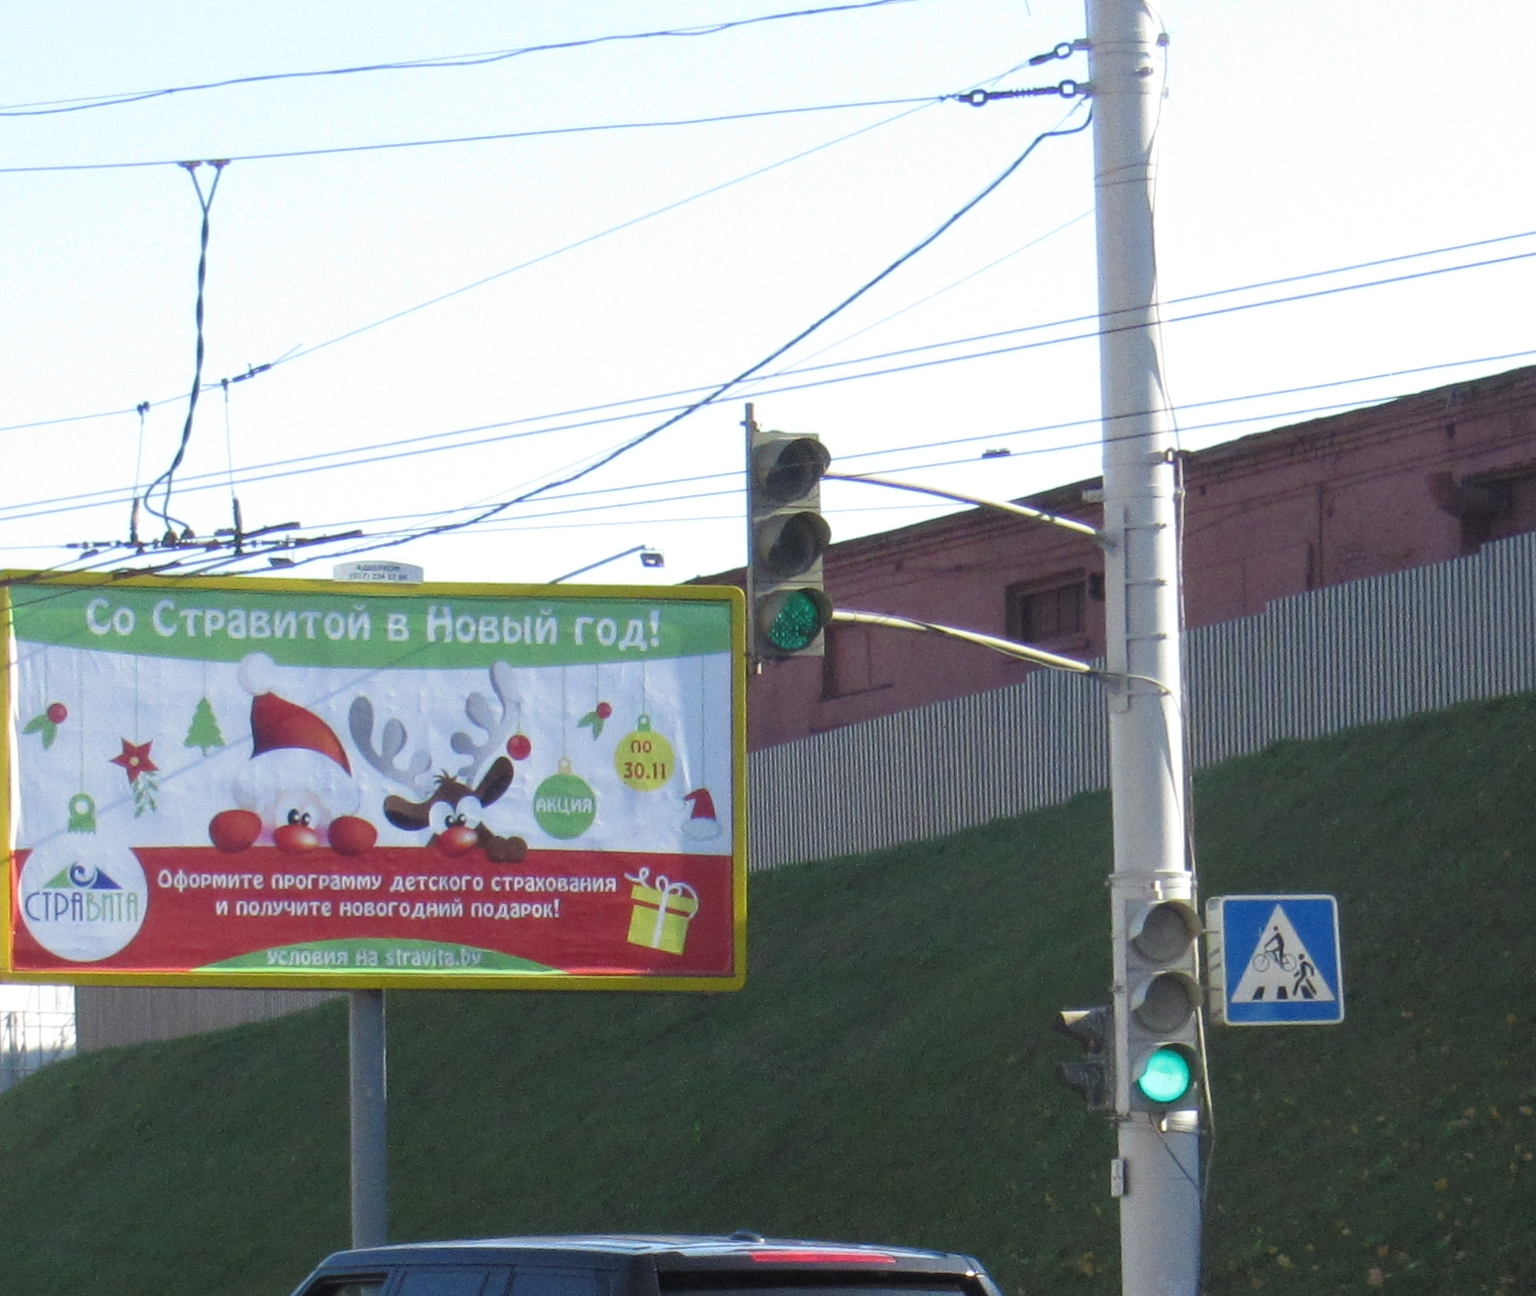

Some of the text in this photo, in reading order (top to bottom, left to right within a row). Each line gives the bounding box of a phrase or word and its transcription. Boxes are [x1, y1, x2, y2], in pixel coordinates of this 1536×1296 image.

[86, 598, 661, 652] Со Стравитой в Новый год!
[630, 740, 653, 754] по
[623, 761, 668, 780] 30.11
[535, 797, 594, 816] АКЦИЯ
[157, 869, 618, 893] Оформите программу детского страхования
[215, 898, 561, 920] и получите новогодний подарок!
[266, 949, 483, 967] условия на stravita.by
